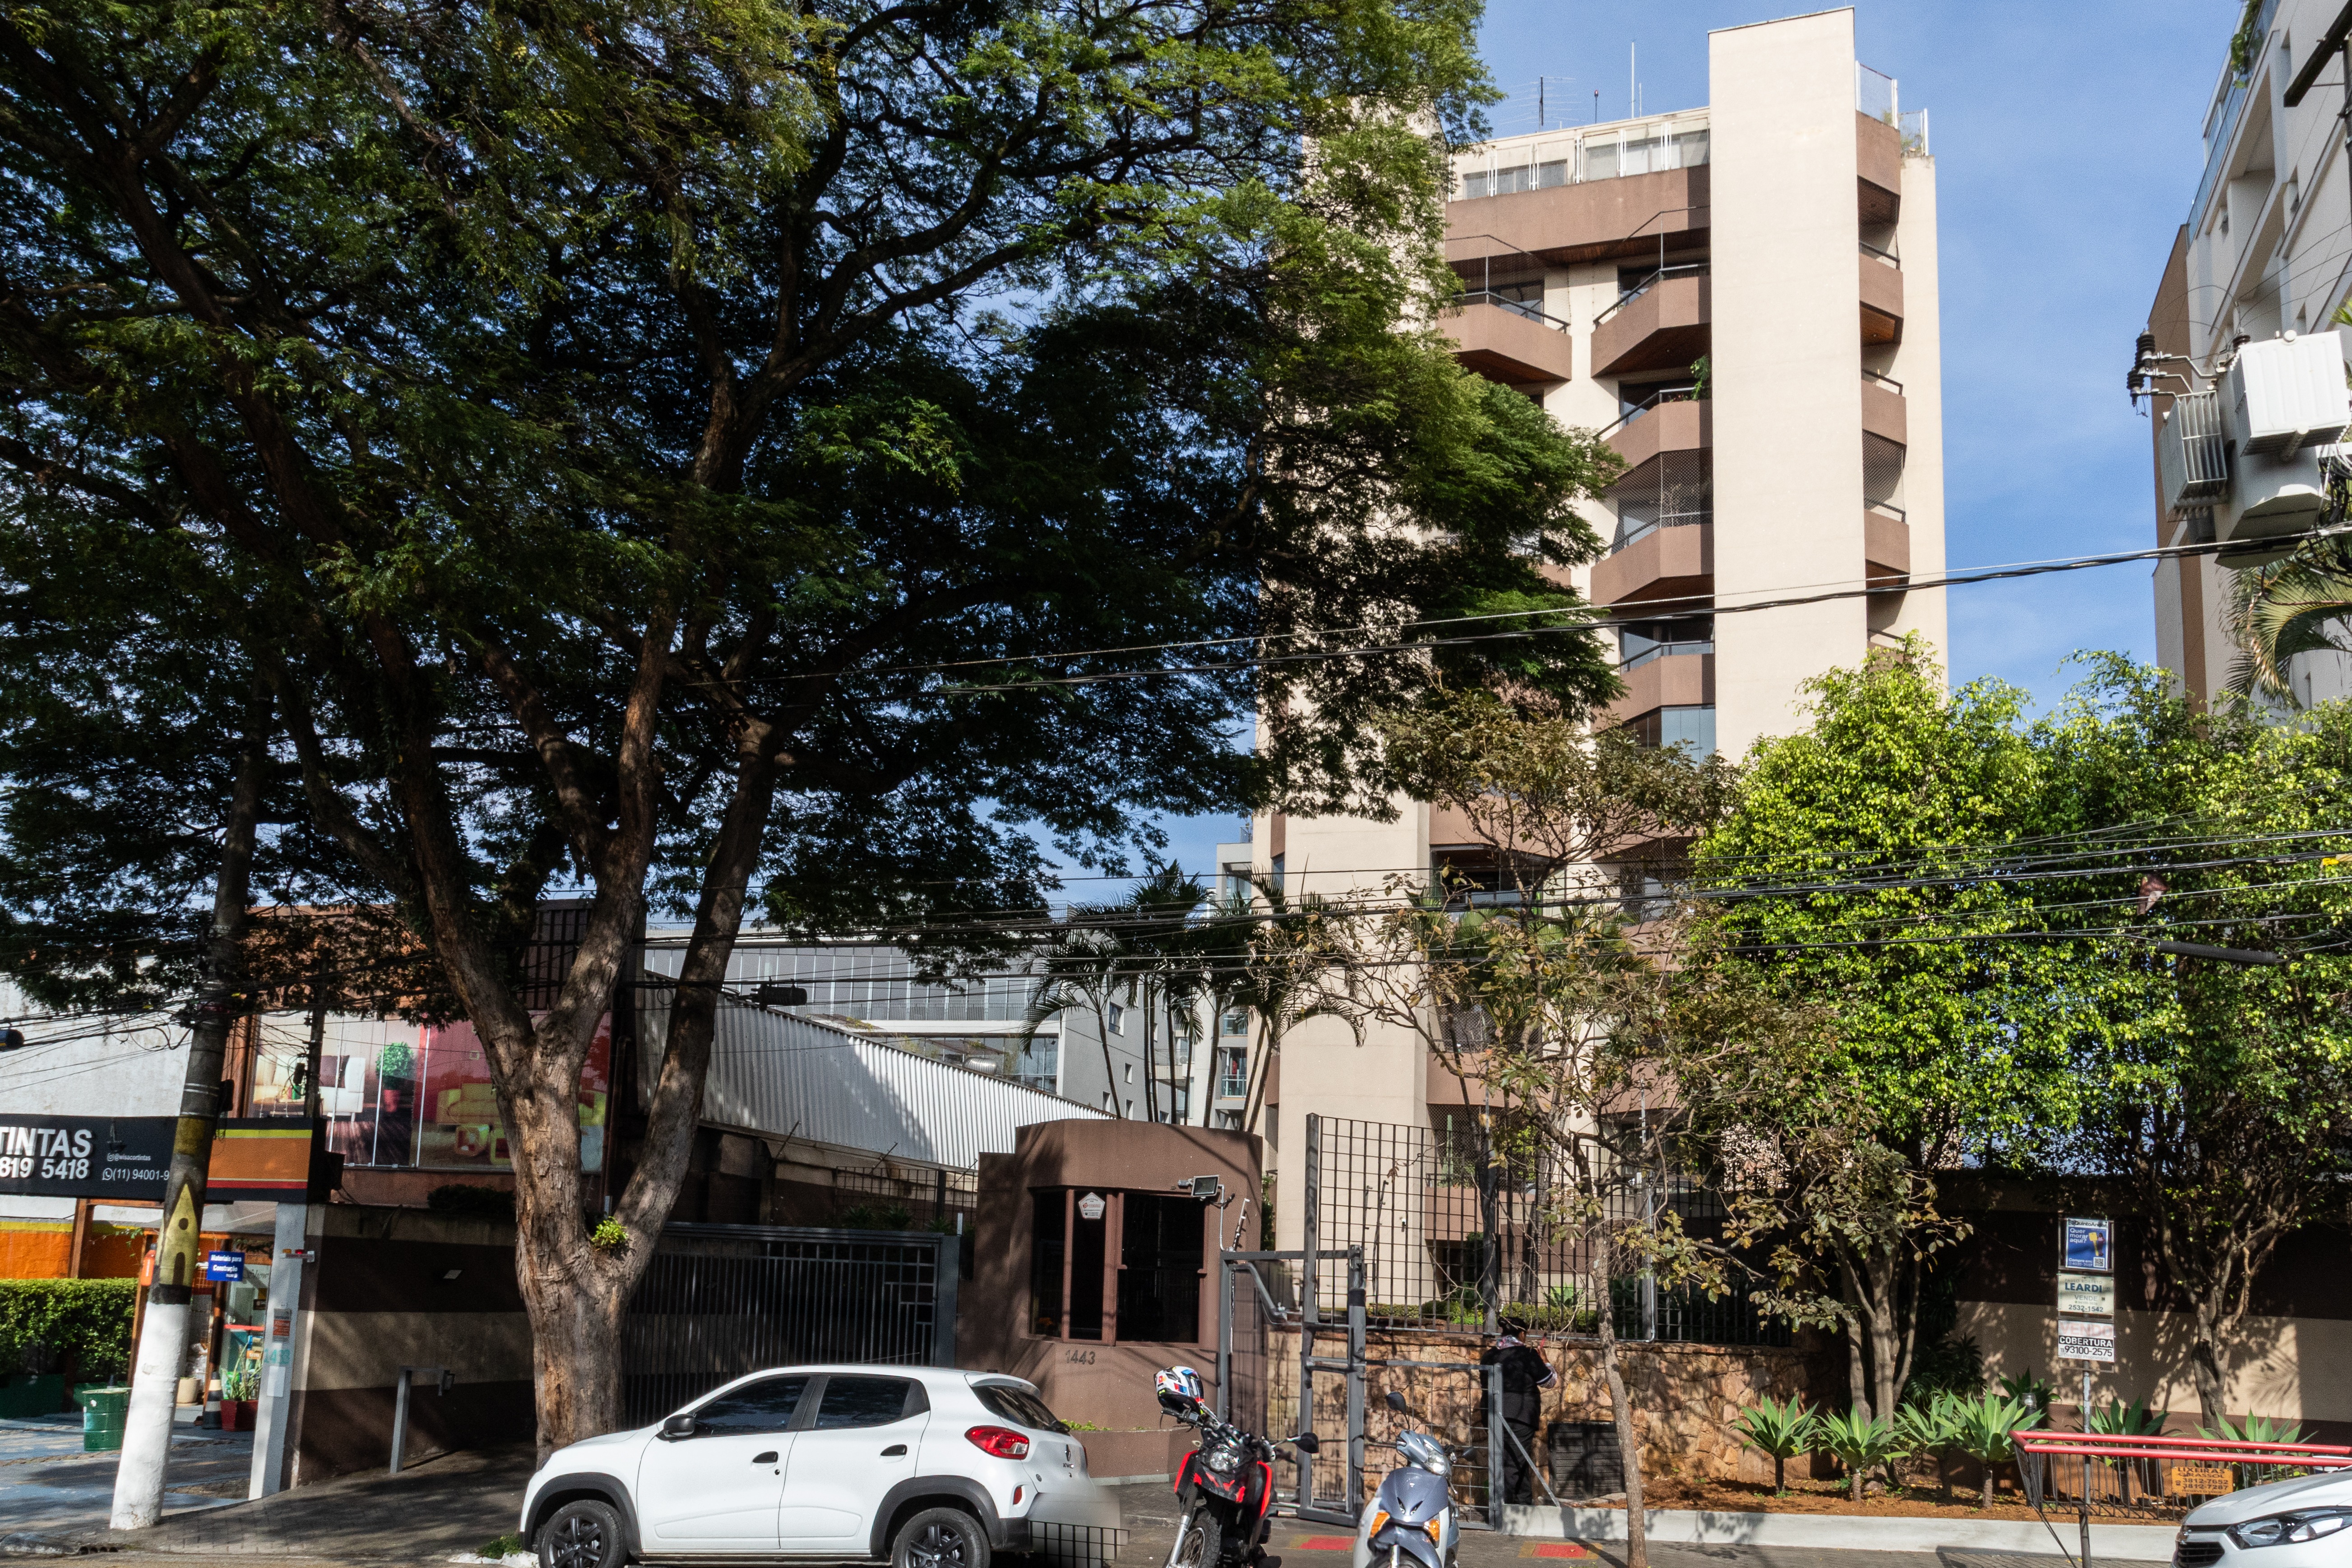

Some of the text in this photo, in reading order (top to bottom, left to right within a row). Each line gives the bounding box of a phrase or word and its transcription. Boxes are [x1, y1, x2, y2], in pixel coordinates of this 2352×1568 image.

[42, 1158, 89, 1179] 5418
[113, 1168, 130, 1181] (11)
[2065, 1282, 2102, 1293] LEARDI
[2060, 1322, 2112, 1338] VENDO
[2060, 1336, 2112, 1348] COBERTURA
[1065, 1350, 1096, 1365] 1443
[2065, 1345, 2112, 1357] 93100-2575
